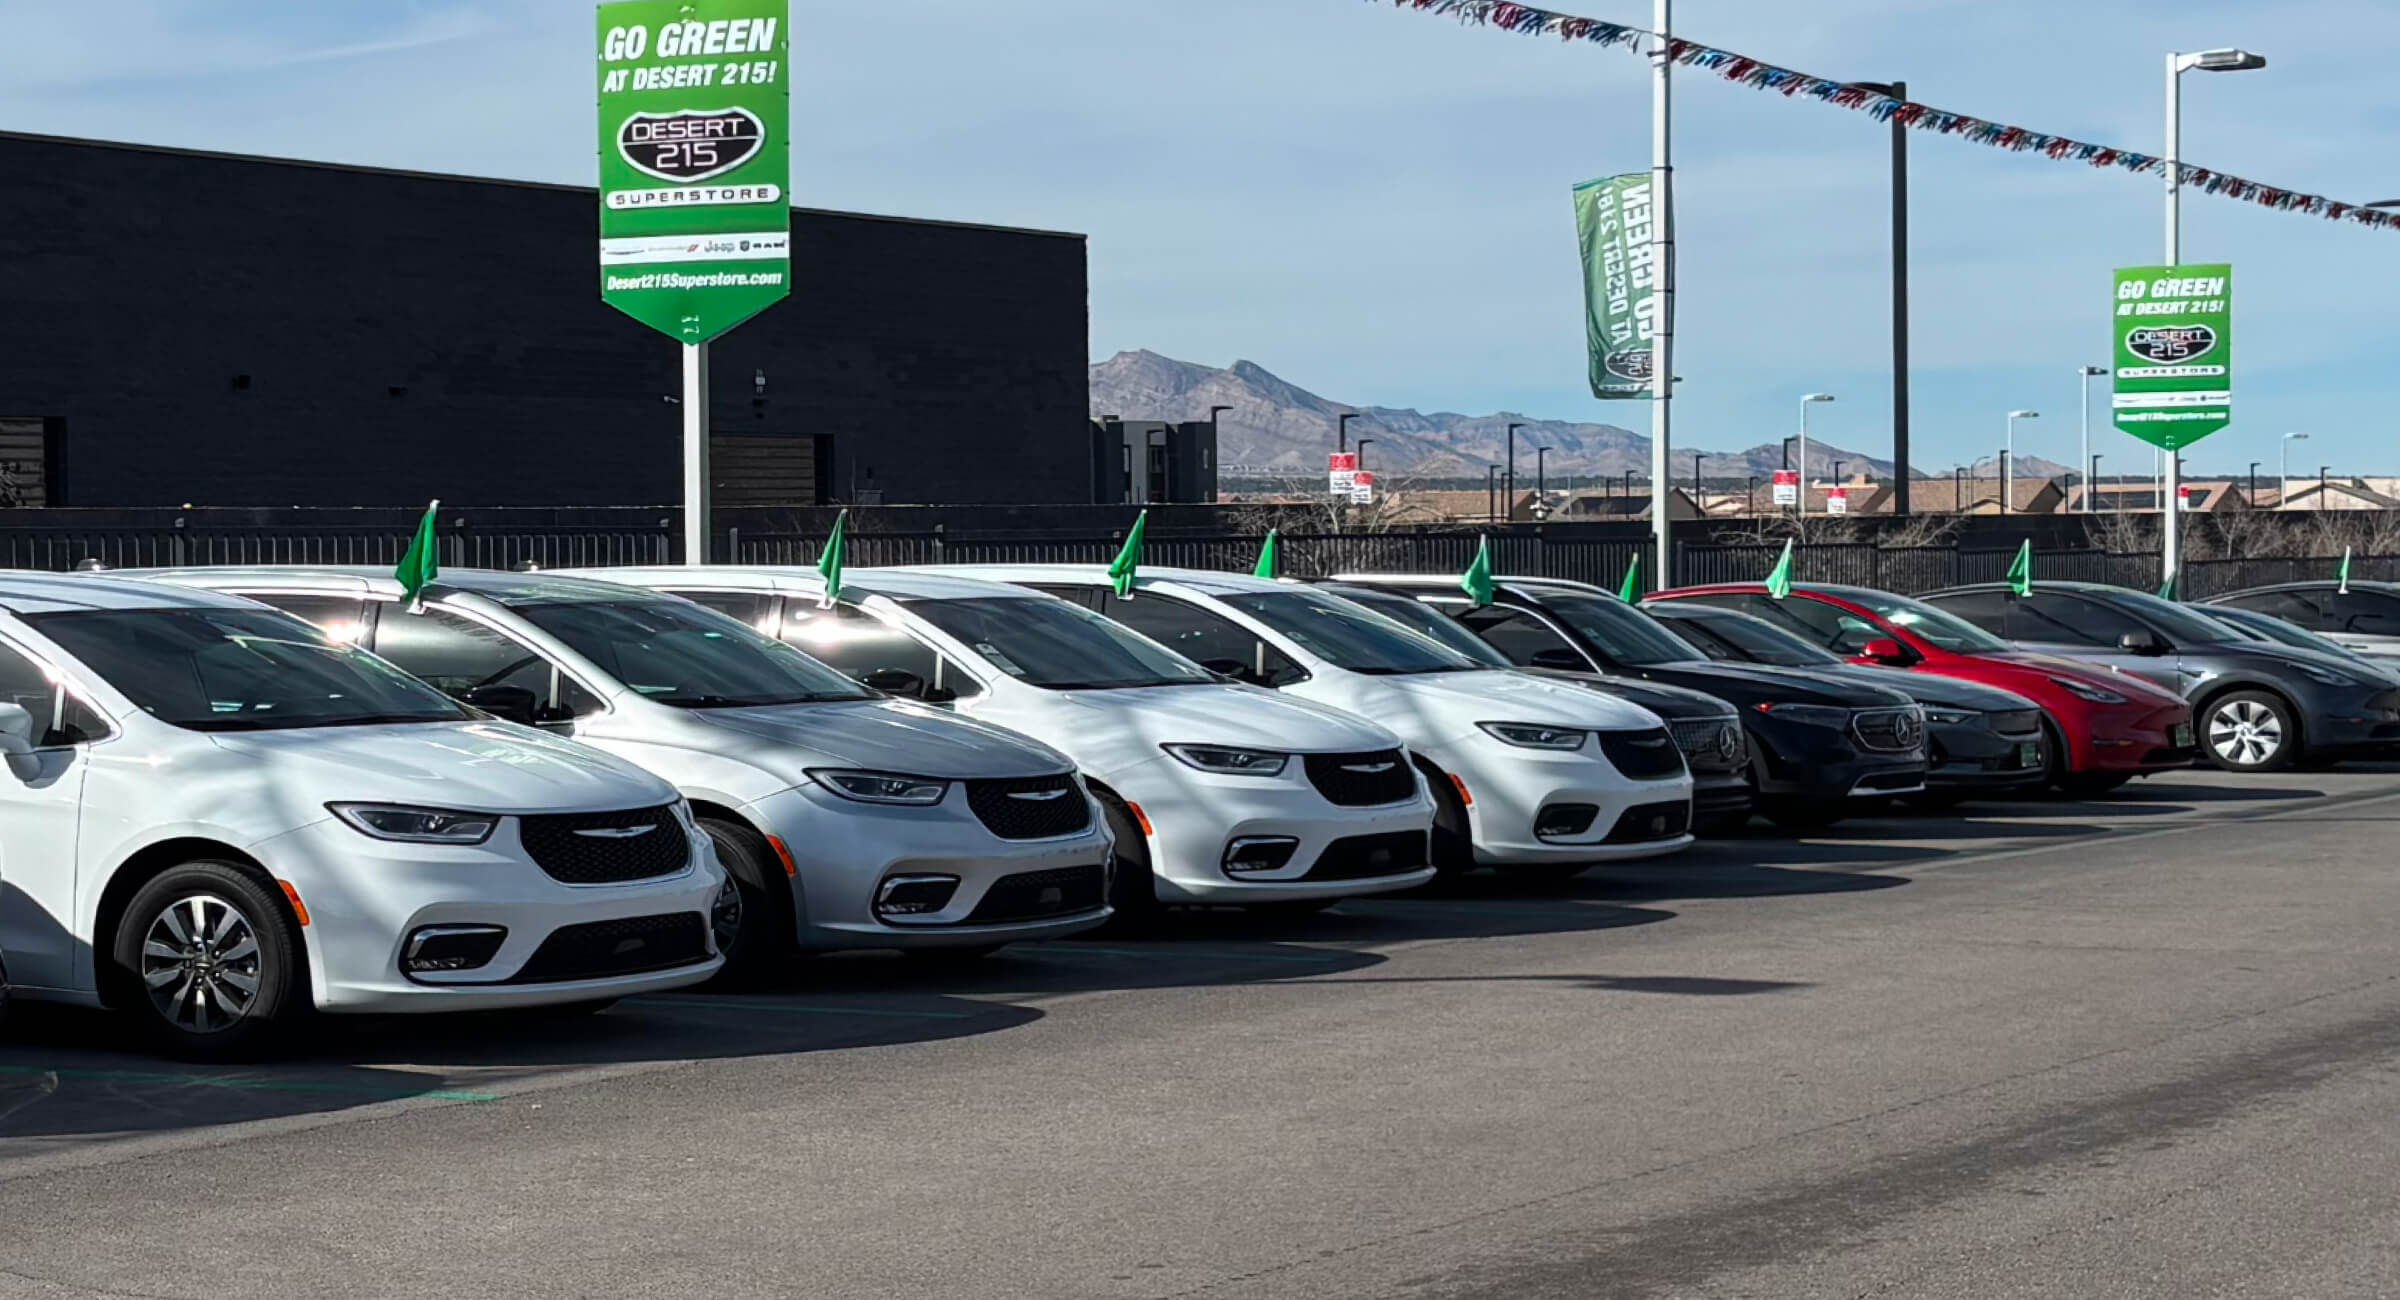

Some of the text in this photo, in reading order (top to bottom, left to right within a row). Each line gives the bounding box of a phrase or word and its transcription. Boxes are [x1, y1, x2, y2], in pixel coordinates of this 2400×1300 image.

[605, 17, 777, 61] GO GREEN
[603, 61, 777, 92] AT DESERT 215!
[631, 118, 745, 141] DESERT
[656, 142, 718, 168] 215
[616, 187, 769, 205] SUPERSTORE
[607, 271, 782, 291] Desert215Superstore.com
[2118, 277, 2224, 300] GO GREEN
[2117, 300, 2224, 316] AT DESERT 215!
[2135, 330, 2205, 342] DESERT
[2149, 342, 2189, 357] 215
